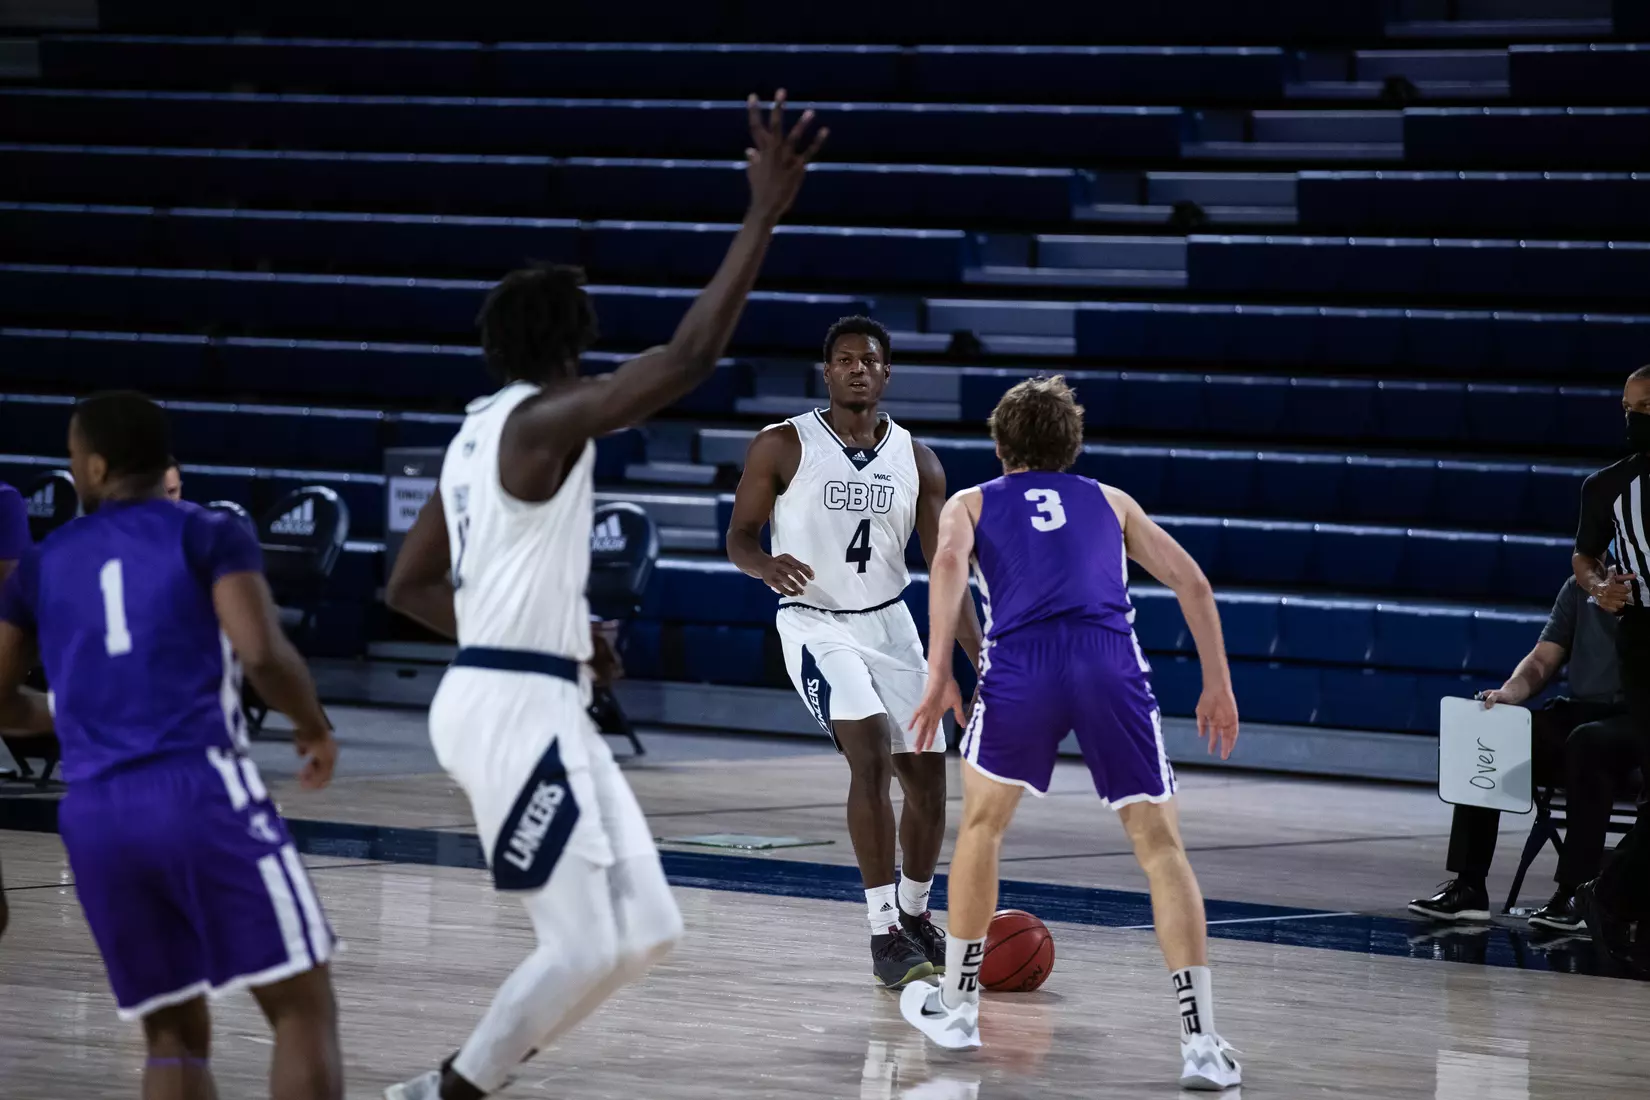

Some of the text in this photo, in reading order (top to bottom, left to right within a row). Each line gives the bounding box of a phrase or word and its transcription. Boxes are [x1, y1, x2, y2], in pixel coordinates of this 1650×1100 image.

[823, 480, 895, 515] CBU
[873, 473, 892, 482] WAC
[1024, 488, 1067, 532] 3
[845, 519, 872, 574] 4
[99, 558, 133, 658] 1
[1469, 736, 1497, 790] Over
[503, 780, 565, 872] LANCERS
